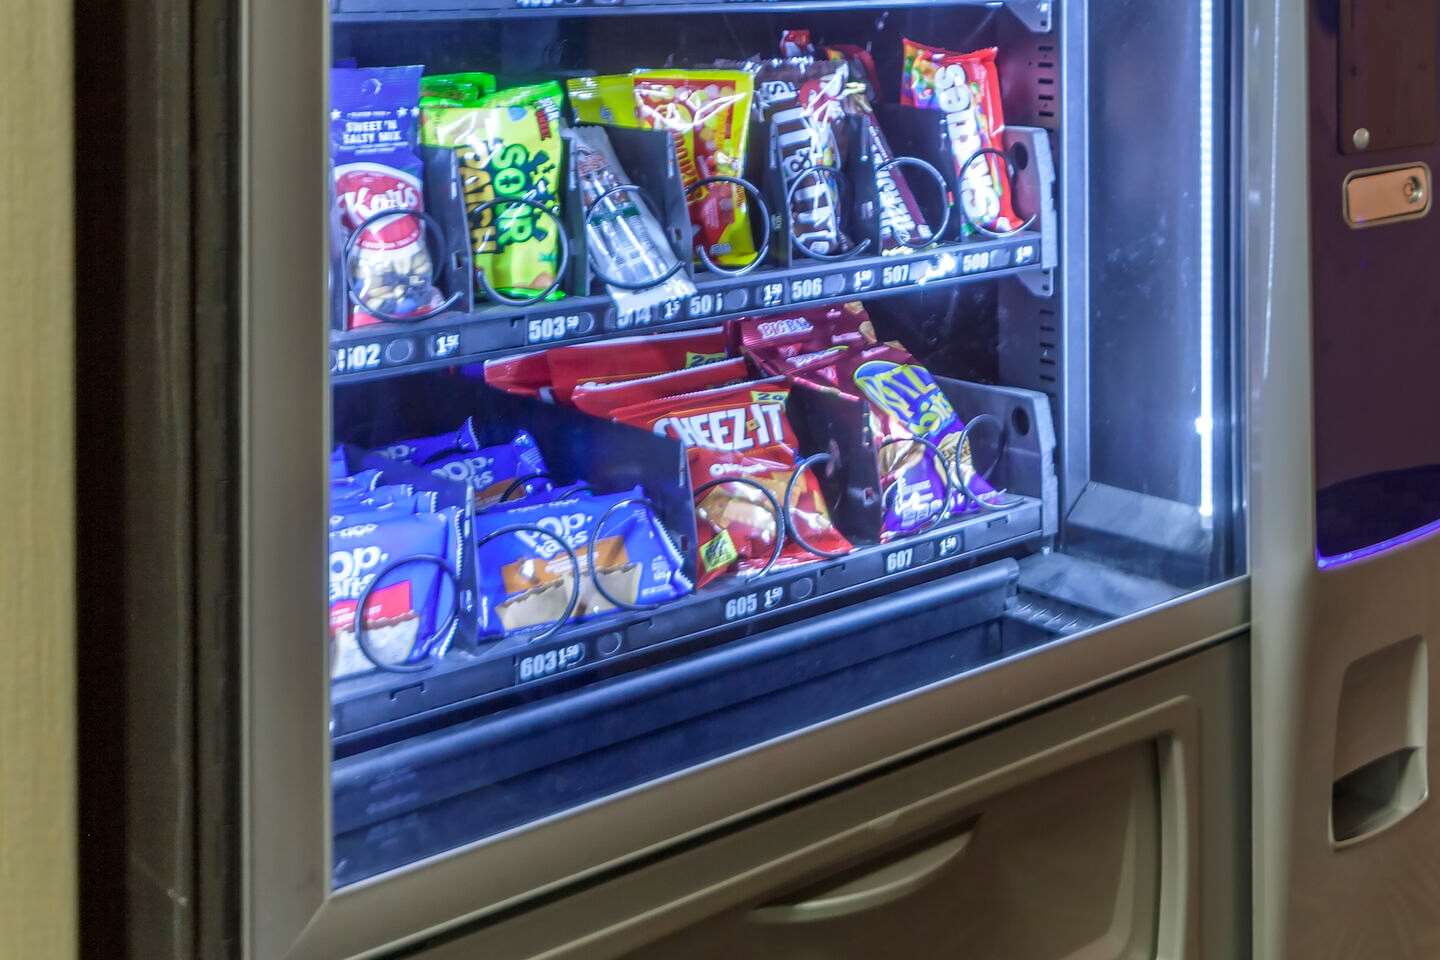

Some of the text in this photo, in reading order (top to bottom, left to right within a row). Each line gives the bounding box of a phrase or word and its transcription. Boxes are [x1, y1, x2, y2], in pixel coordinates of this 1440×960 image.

[791, 278, 823, 299] 506
[529, 315, 566, 342] 503
[887, 548, 913, 573] 607
[725, 593, 758, 620] 605
[520, 650, 556, 681] 603
